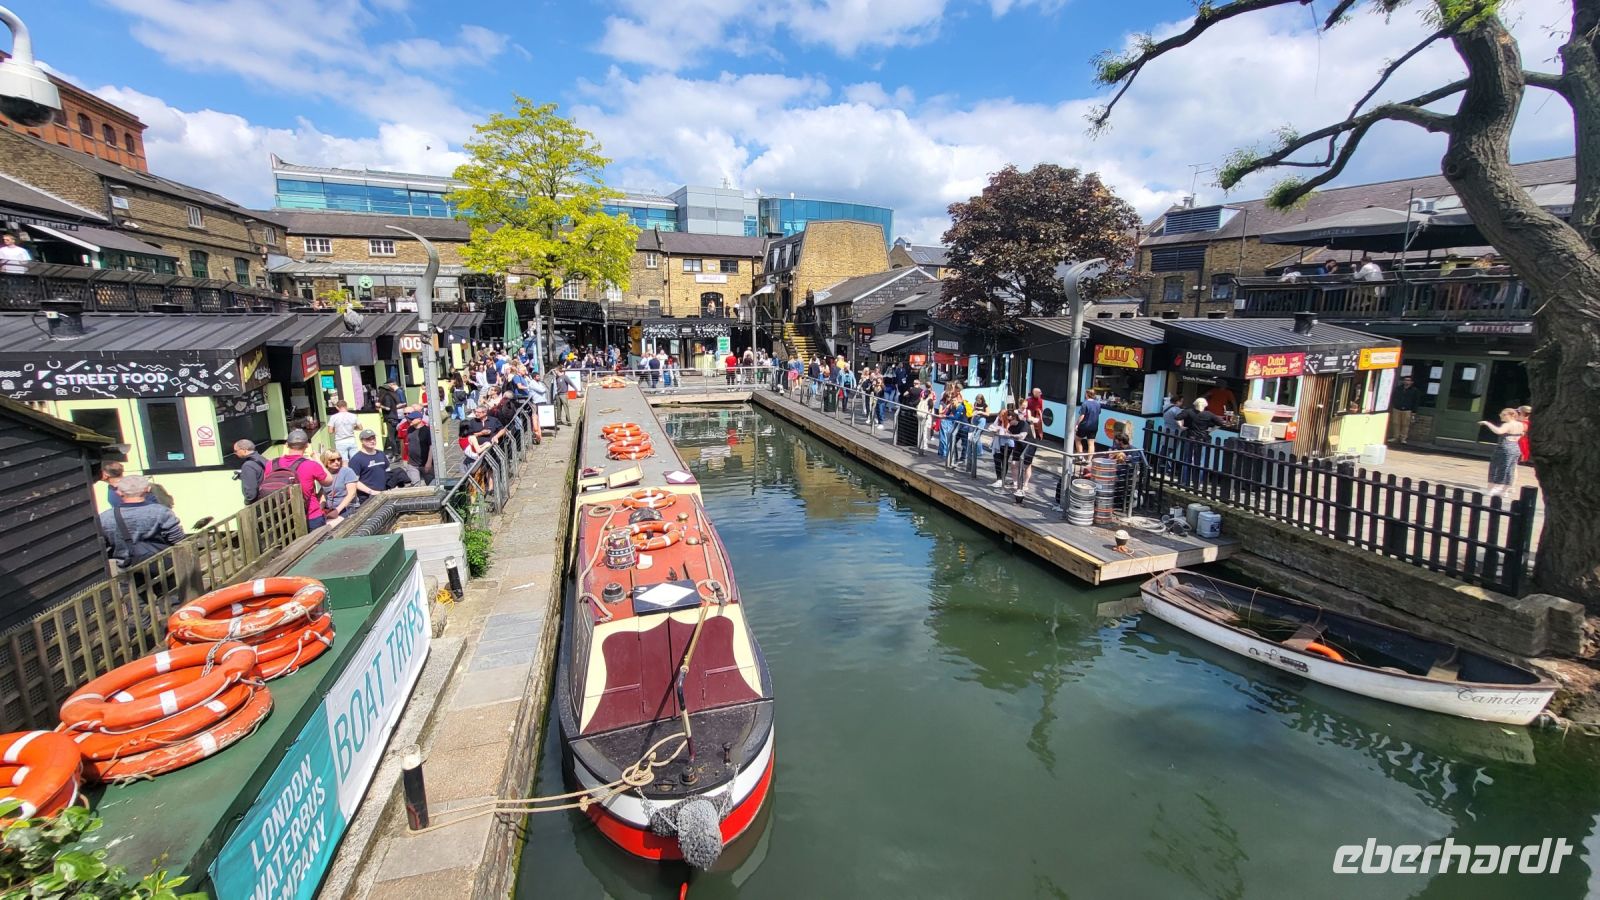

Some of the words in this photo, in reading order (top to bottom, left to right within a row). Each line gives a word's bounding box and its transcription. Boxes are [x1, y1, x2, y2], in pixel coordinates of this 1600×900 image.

[36, 219, 70, 230] BREWERY
[400, 336, 422, 350] OG
[1186, 351, 1213, 362] Dutch
[1267, 355, 1286, 366] Dutch
[1185, 359, 1227, 371] Pancakes
[1262, 365, 1288, 376] Pancakes
[55, 373, 117, 385] STREET
[121, 372, 168, 384] FOOD
[334, 649, 385, 784] BOAT
[386, 592, 425, 684] TRIPS
[1456, 687, 1540, 705] Camden
[251, 753, 312, 872] LONDON
[249, 776, 325, 900] WATERBUS
[278, 812, 326, 900] MPANY
